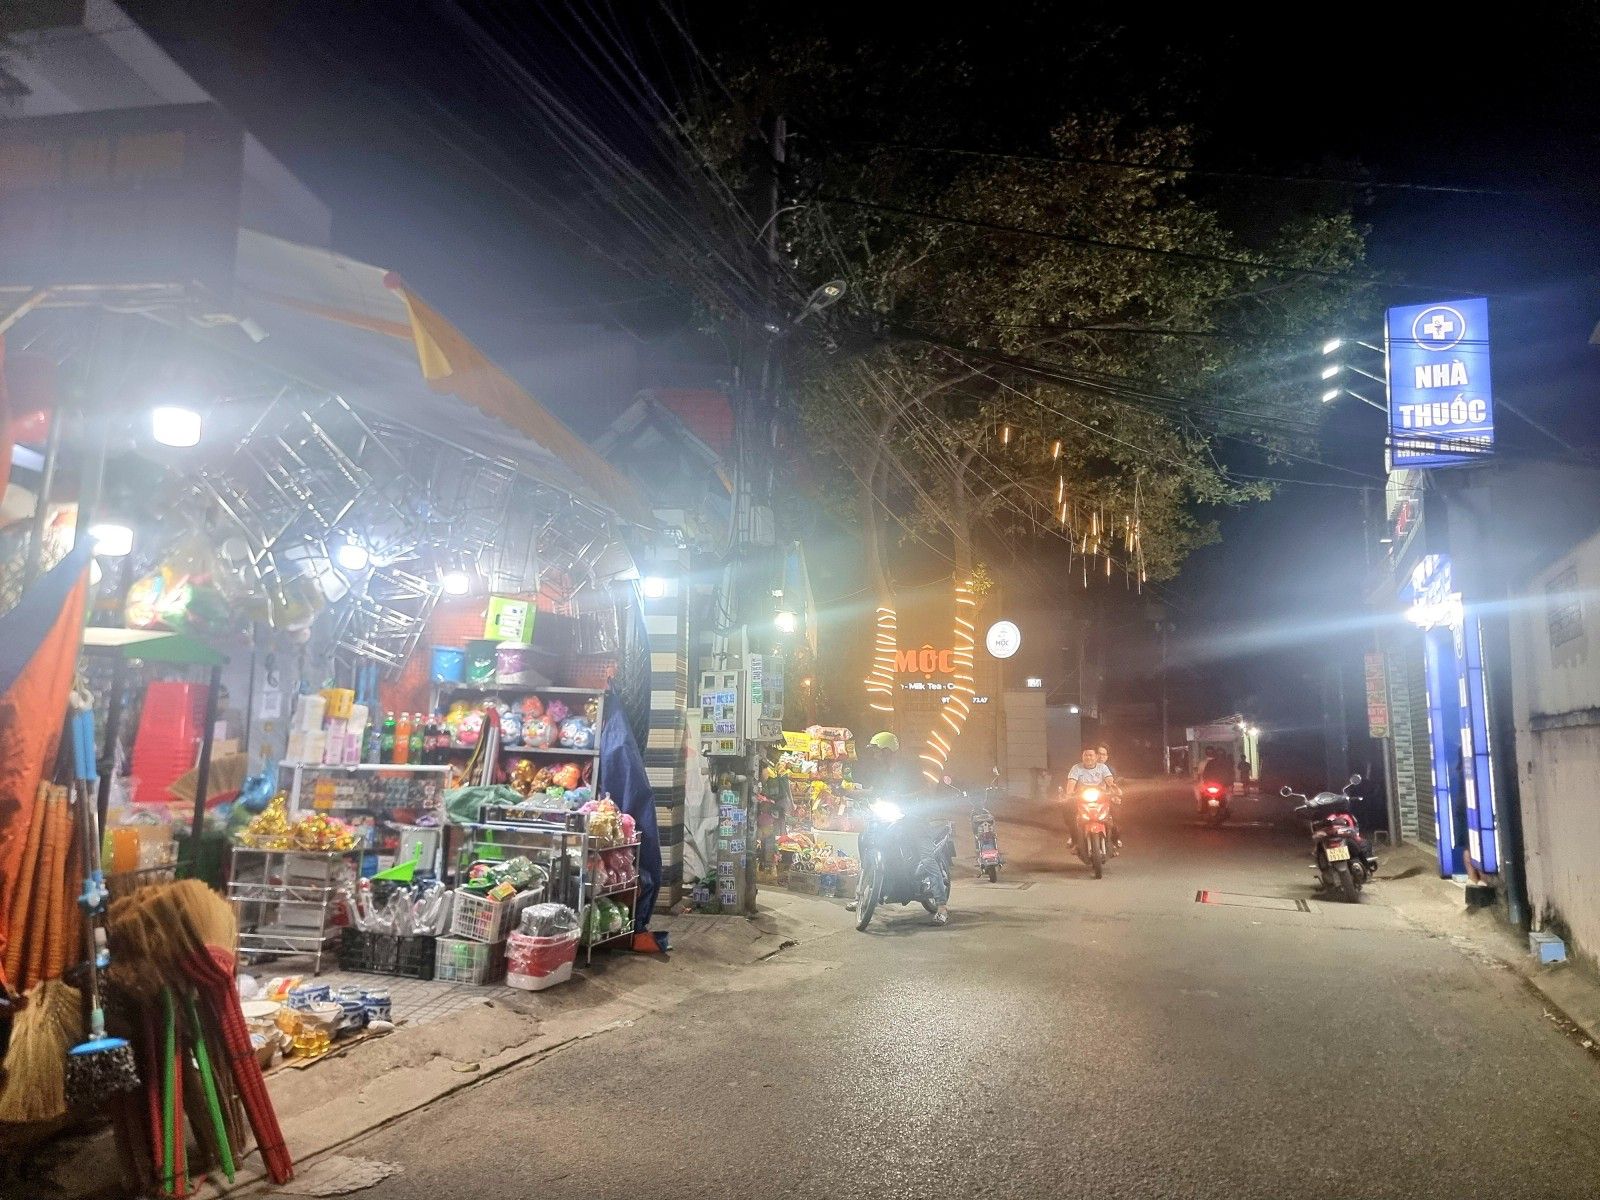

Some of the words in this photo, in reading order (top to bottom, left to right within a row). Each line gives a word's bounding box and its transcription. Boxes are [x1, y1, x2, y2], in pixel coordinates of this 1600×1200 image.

[1415, 359, 1469, 389] NHÀ
[1399, 393, 1487, 429] THUỐC
[894, 644, 957, 680] MỘC
